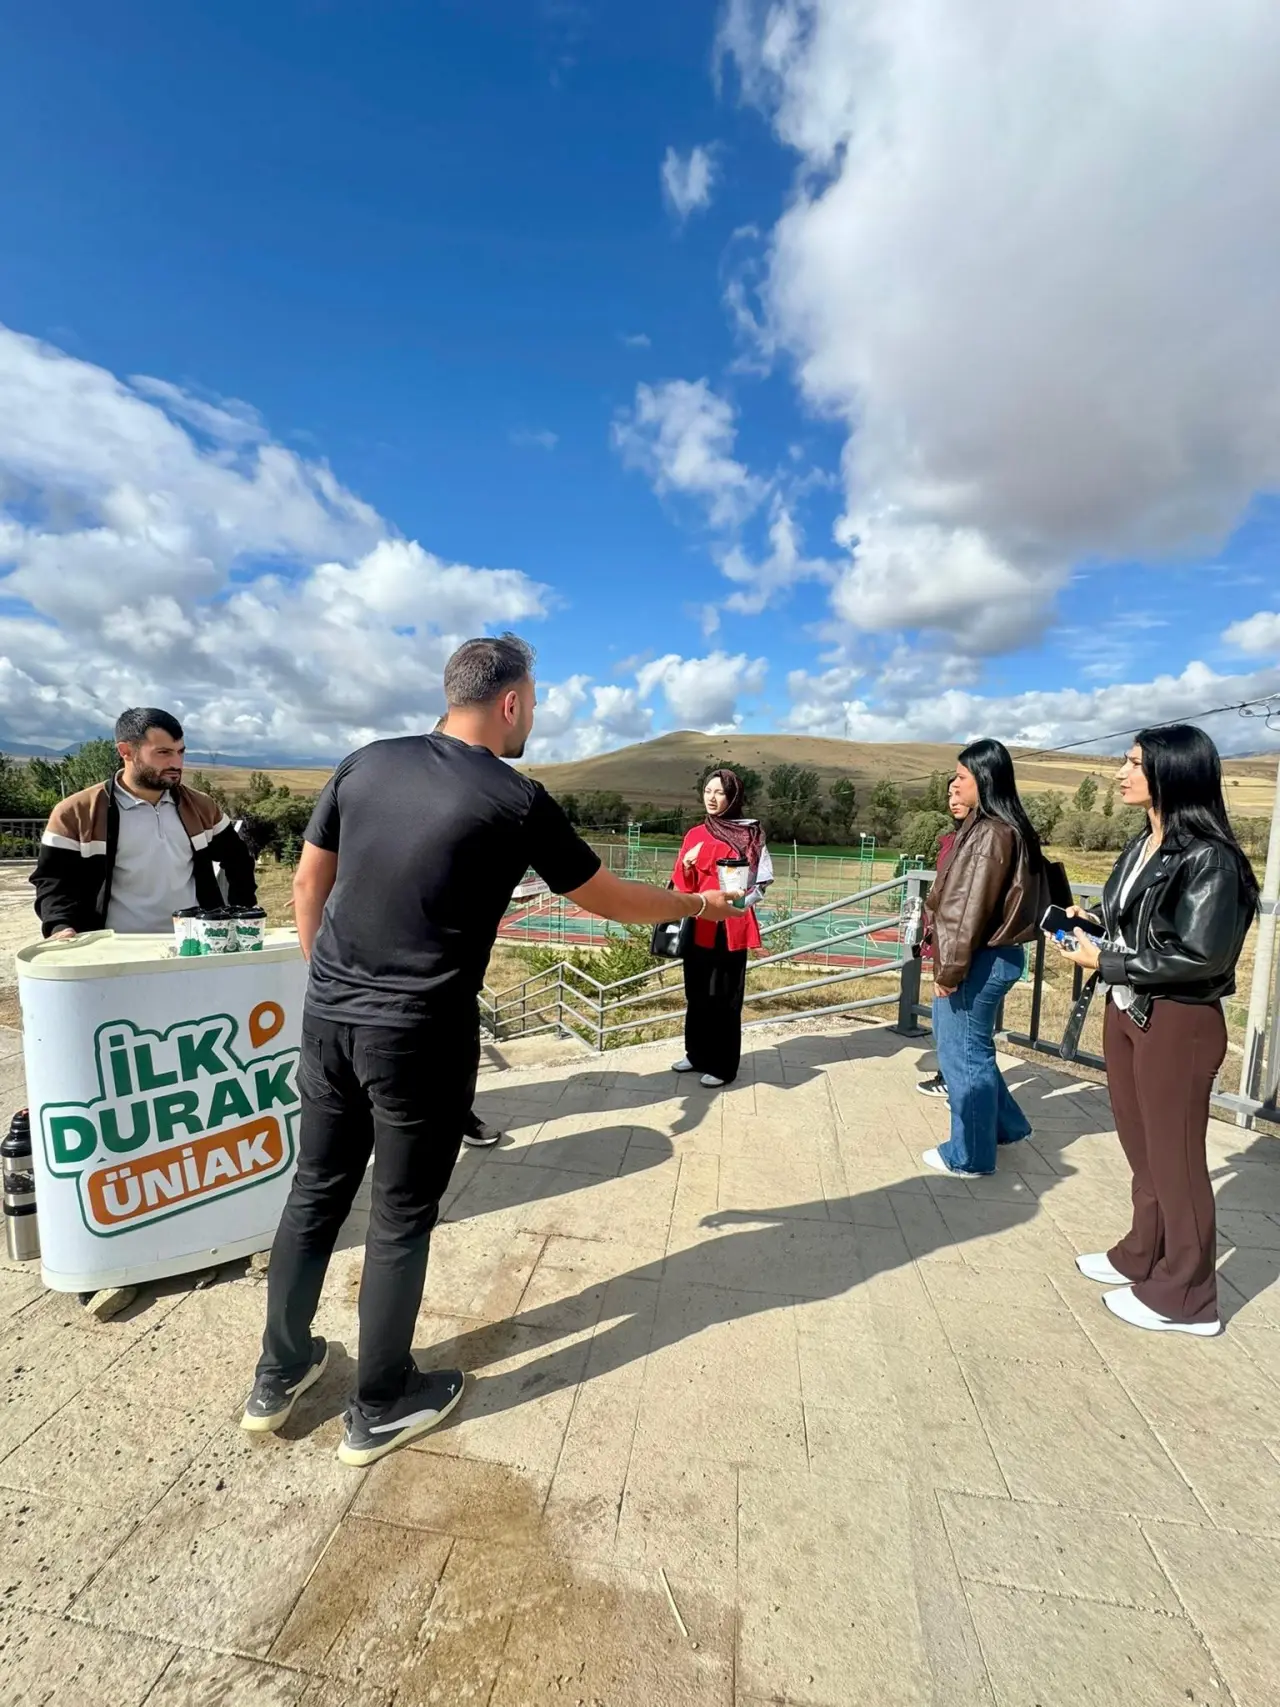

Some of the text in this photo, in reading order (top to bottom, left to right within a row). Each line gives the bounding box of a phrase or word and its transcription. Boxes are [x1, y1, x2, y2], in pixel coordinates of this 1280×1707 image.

[109, 1027, 228, 1097] İLK
[49, 1060, 299, 1164] DURAK
[101, 1130, 275, 1216] ÜNİAK
